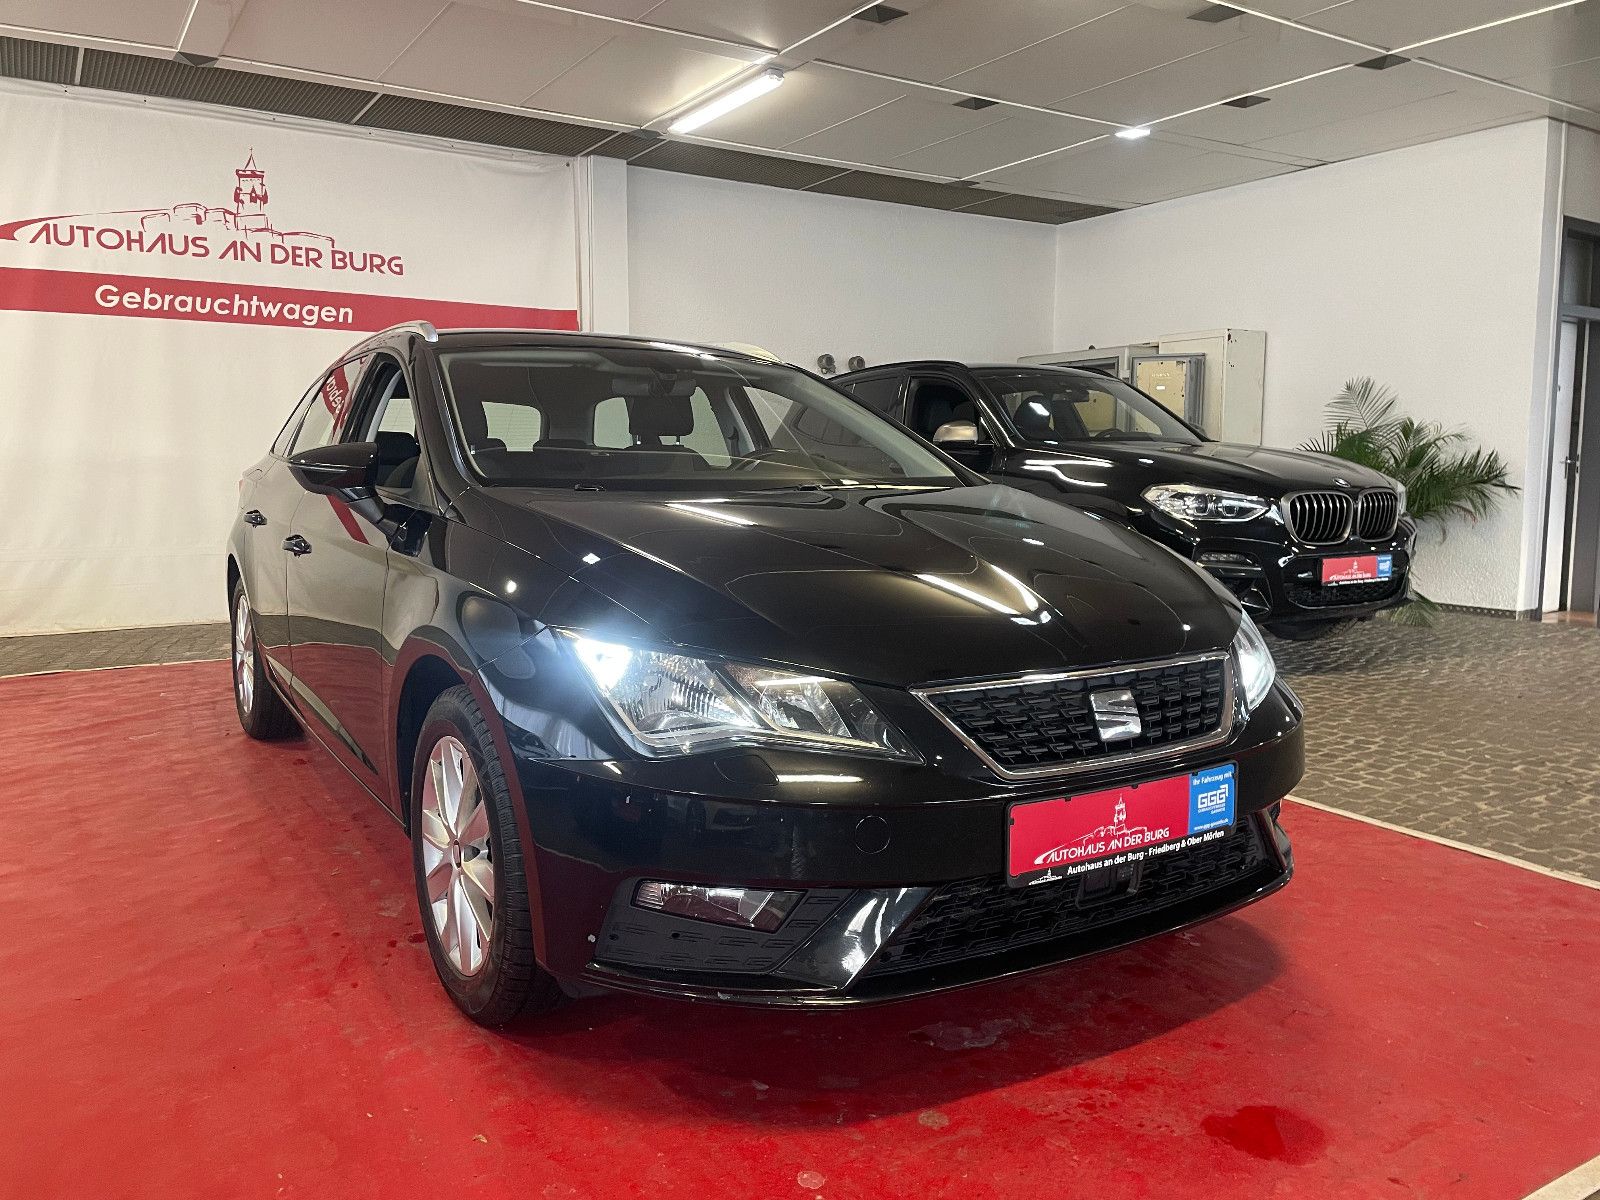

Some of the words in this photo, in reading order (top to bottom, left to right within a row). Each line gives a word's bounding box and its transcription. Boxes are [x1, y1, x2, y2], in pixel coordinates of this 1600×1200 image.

[29, 222, 210, 258] AUTOHAUS
[218, 240, 262, 263] AN
[270, 243, 323, 269] DER
[331, 249, 404, 276] BURG
[94, 284, 353, 326] Gebrauchtwagen
[1197, 789, 1226, 809] GGG
[1046, 842, 1106, 864] AUTOHAUS
[1107, 839, 1122, 852] AN
[1124, 834, 1143, 848] DER
[1144, 827, 1169, 843] BURG
[1066, 861, 1103, 876] Autohaus
[1104, 858, 1114, 867] an
[1114, 854, 1127, 865] der
[1127, 851, 1145, 861] Burg
[1148, 842, 1181, 857] Friedberg
[1181, 839, 1187, 848] &
[1187, 836, 1202, 847] Ober
